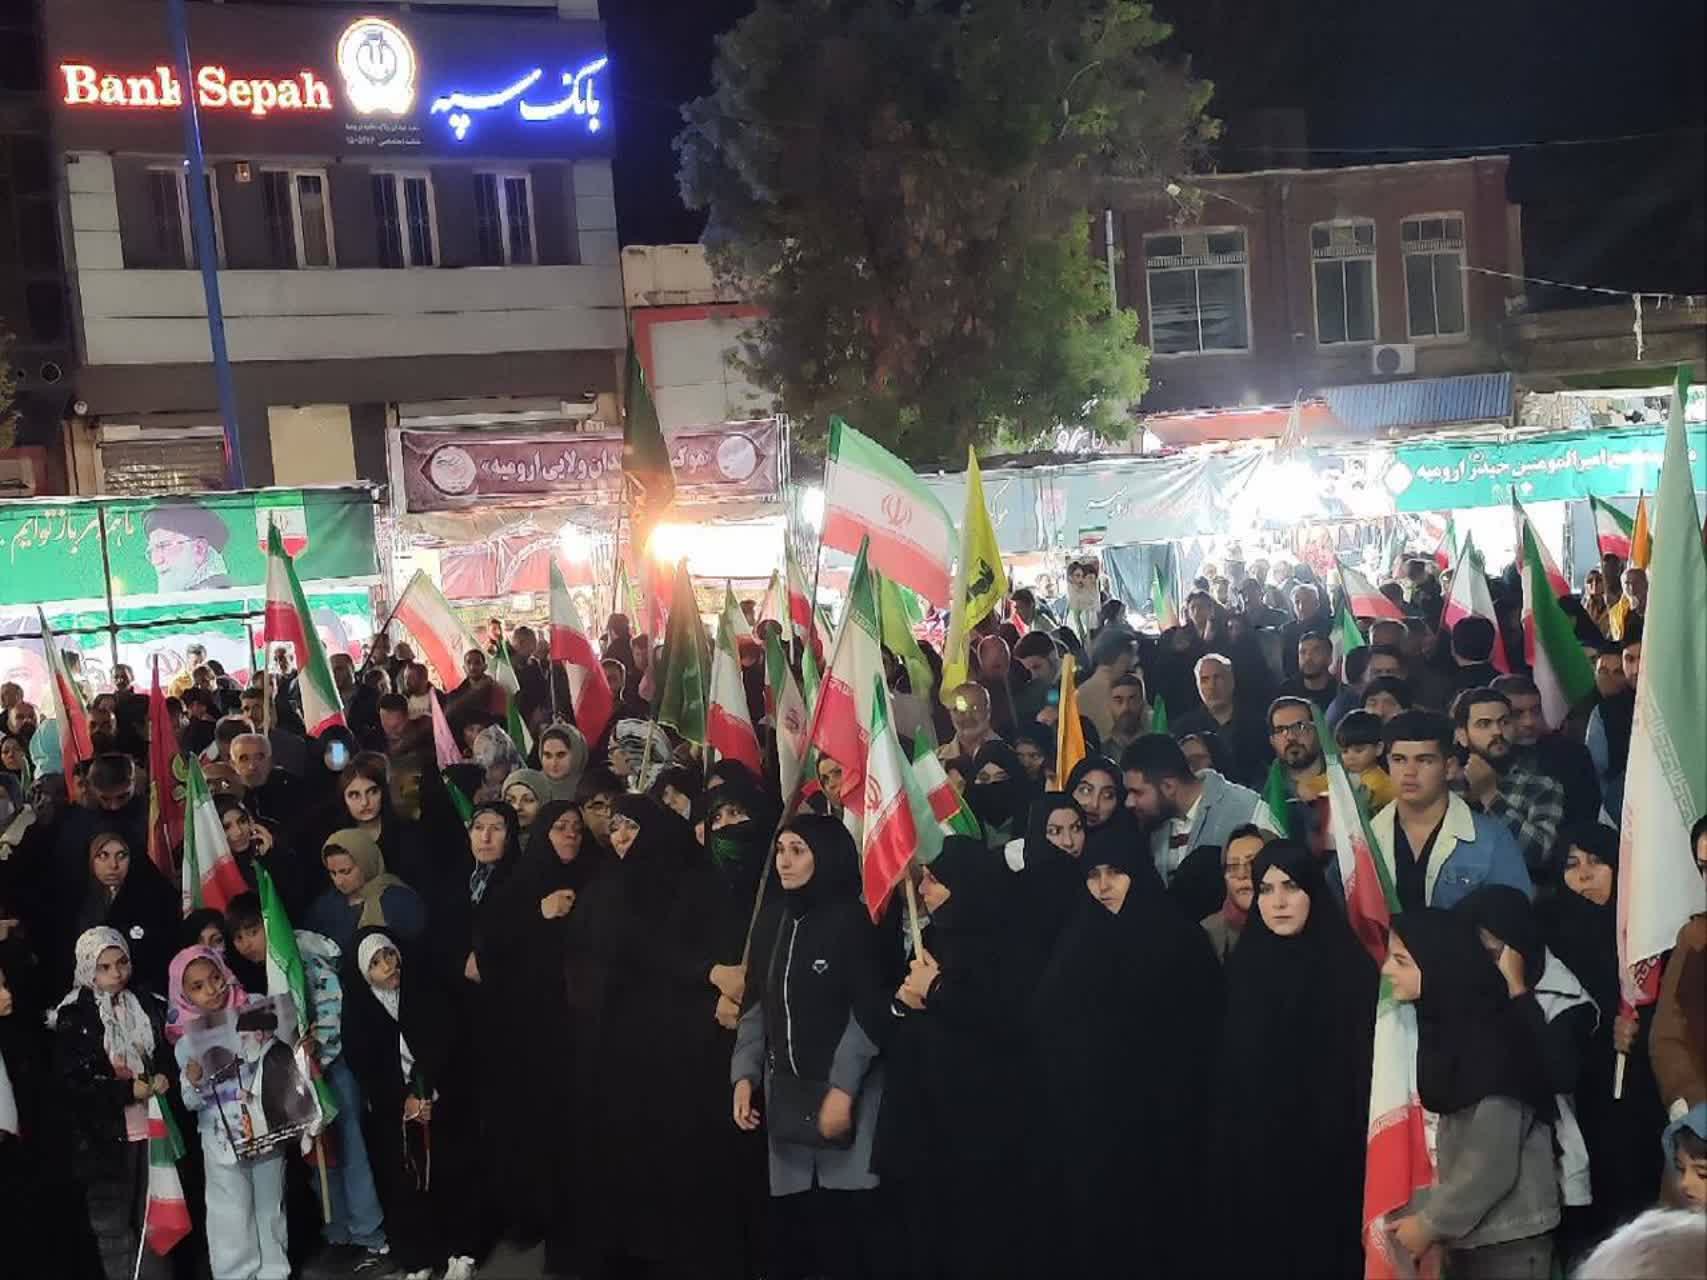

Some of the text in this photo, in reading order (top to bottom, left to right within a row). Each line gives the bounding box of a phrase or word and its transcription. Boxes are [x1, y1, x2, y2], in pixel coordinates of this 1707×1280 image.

[60, 63, 333, 115] Bank Sepah
[430, 56, 608, 140] بانک سپه
